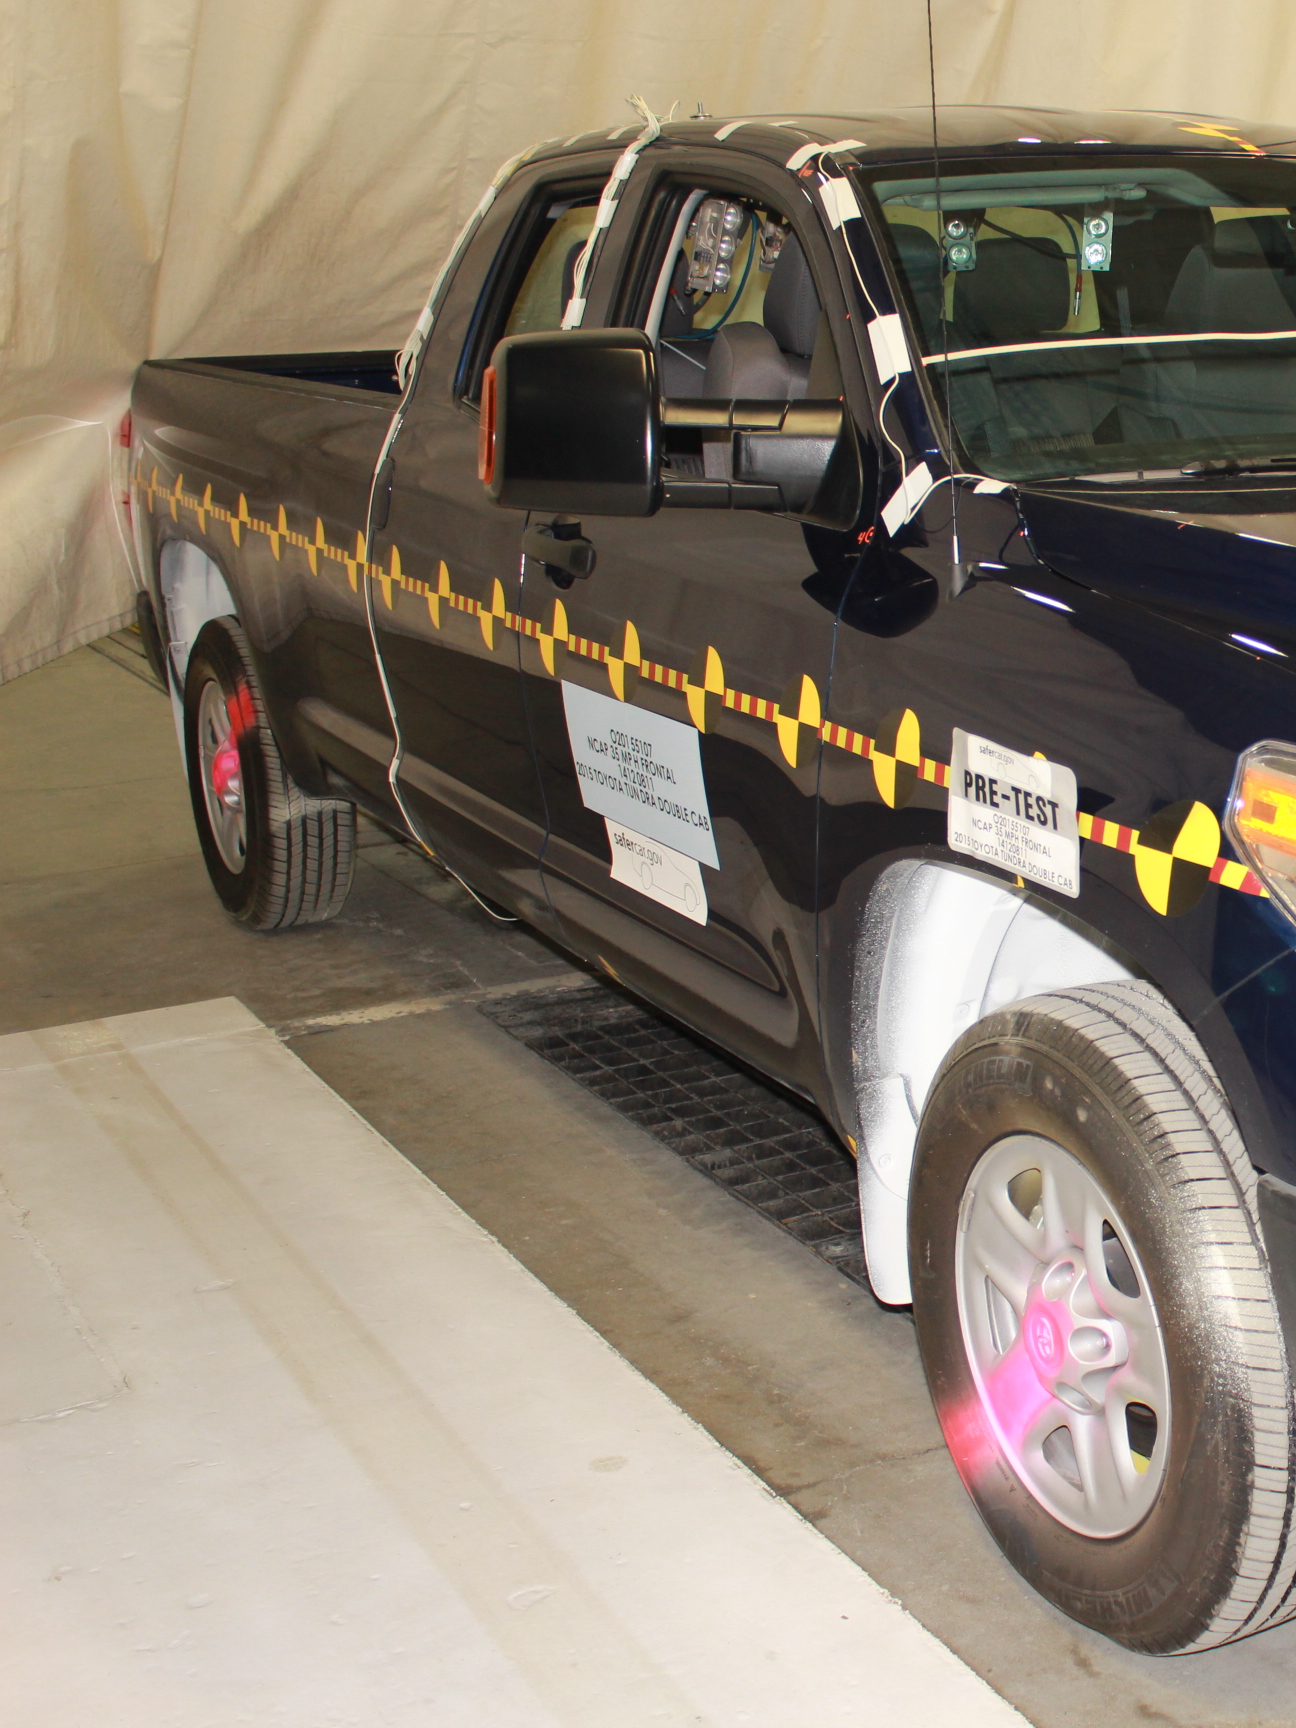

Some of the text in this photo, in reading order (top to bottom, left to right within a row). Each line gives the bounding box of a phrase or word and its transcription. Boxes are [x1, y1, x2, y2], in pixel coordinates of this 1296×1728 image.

[587, 736, 608, 756] NCAP
[610, 745, 620, 761] 35
[640, 757, 676, 785] FRONTAL
[979, 744, 1014, 766] safercar.gov
[576, 761, 710, 832] 2015 TOYOTA TUNDRA DOUBLE CAB
[618, 764, 654, 792] 14120811
[964, 769, 1059, 831] PRE-TEST
[614, 832, 662, 866] safercar.gov
[972, 817, 1052, 858] NCAP 35 MPH FRONTAL
[998, 837, 1028, 860] 14120811
[1000, 849, 1027, 870] TUNDRA
[1028, 862, 1056, 883] DOUBLE
[1057, 874, 1074, 890] CAB
